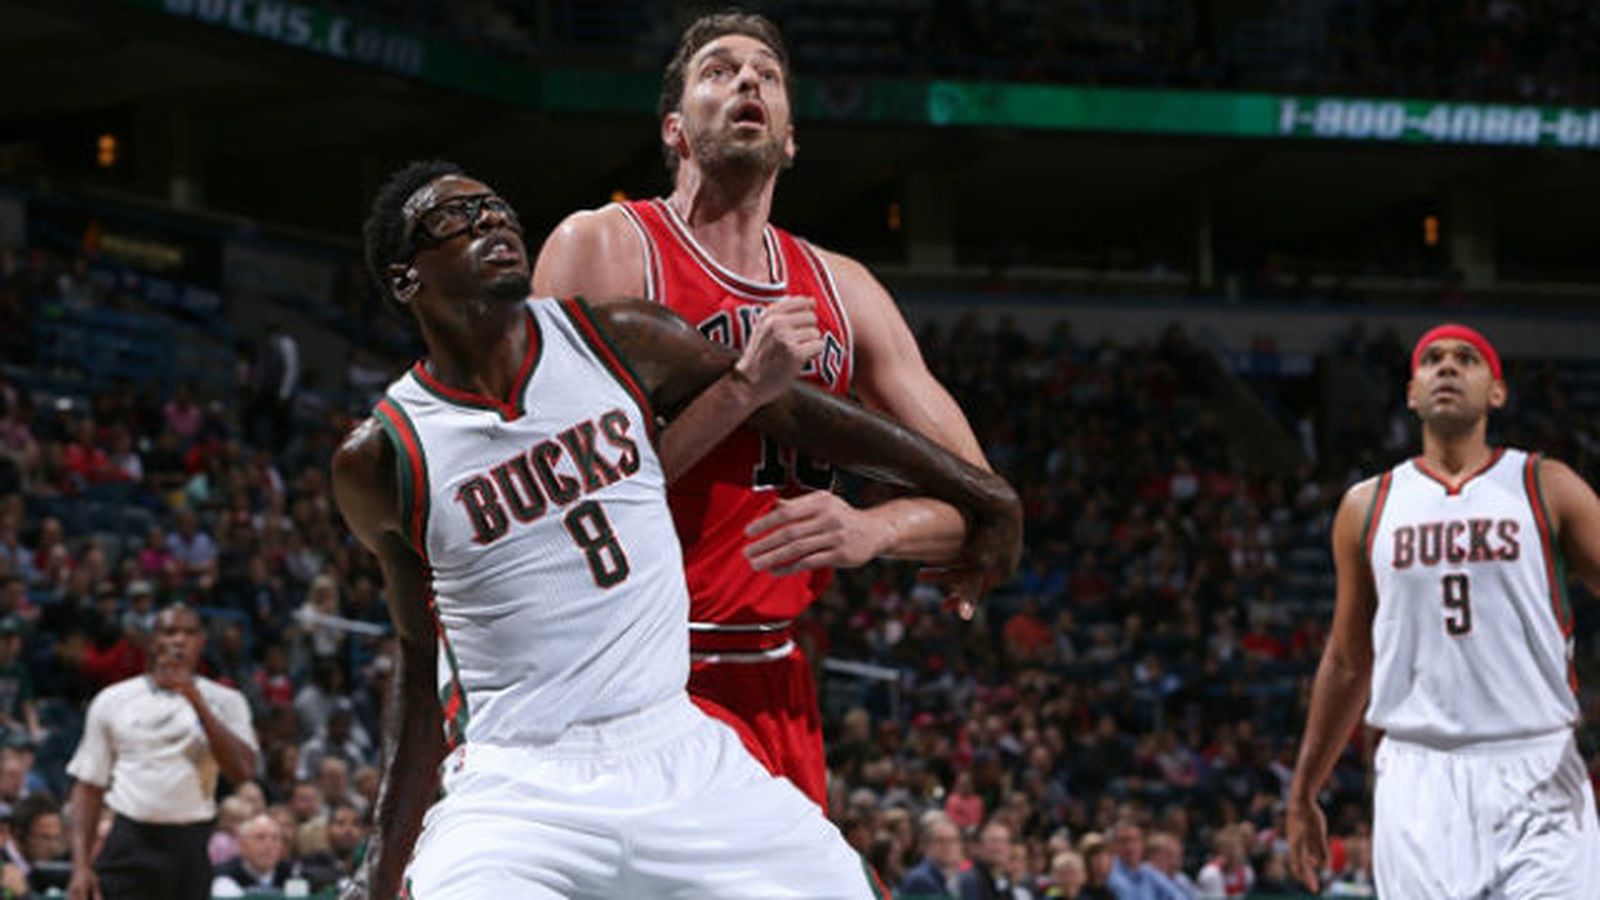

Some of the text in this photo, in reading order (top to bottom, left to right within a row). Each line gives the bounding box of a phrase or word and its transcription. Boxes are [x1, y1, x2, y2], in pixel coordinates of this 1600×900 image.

[454, 409, 641, 546] BUCKS
[563, 499, 631, 590] 8
[1392, 518, 1521, 570] BUCKS
[1442, 573, 1473, 636] 9
